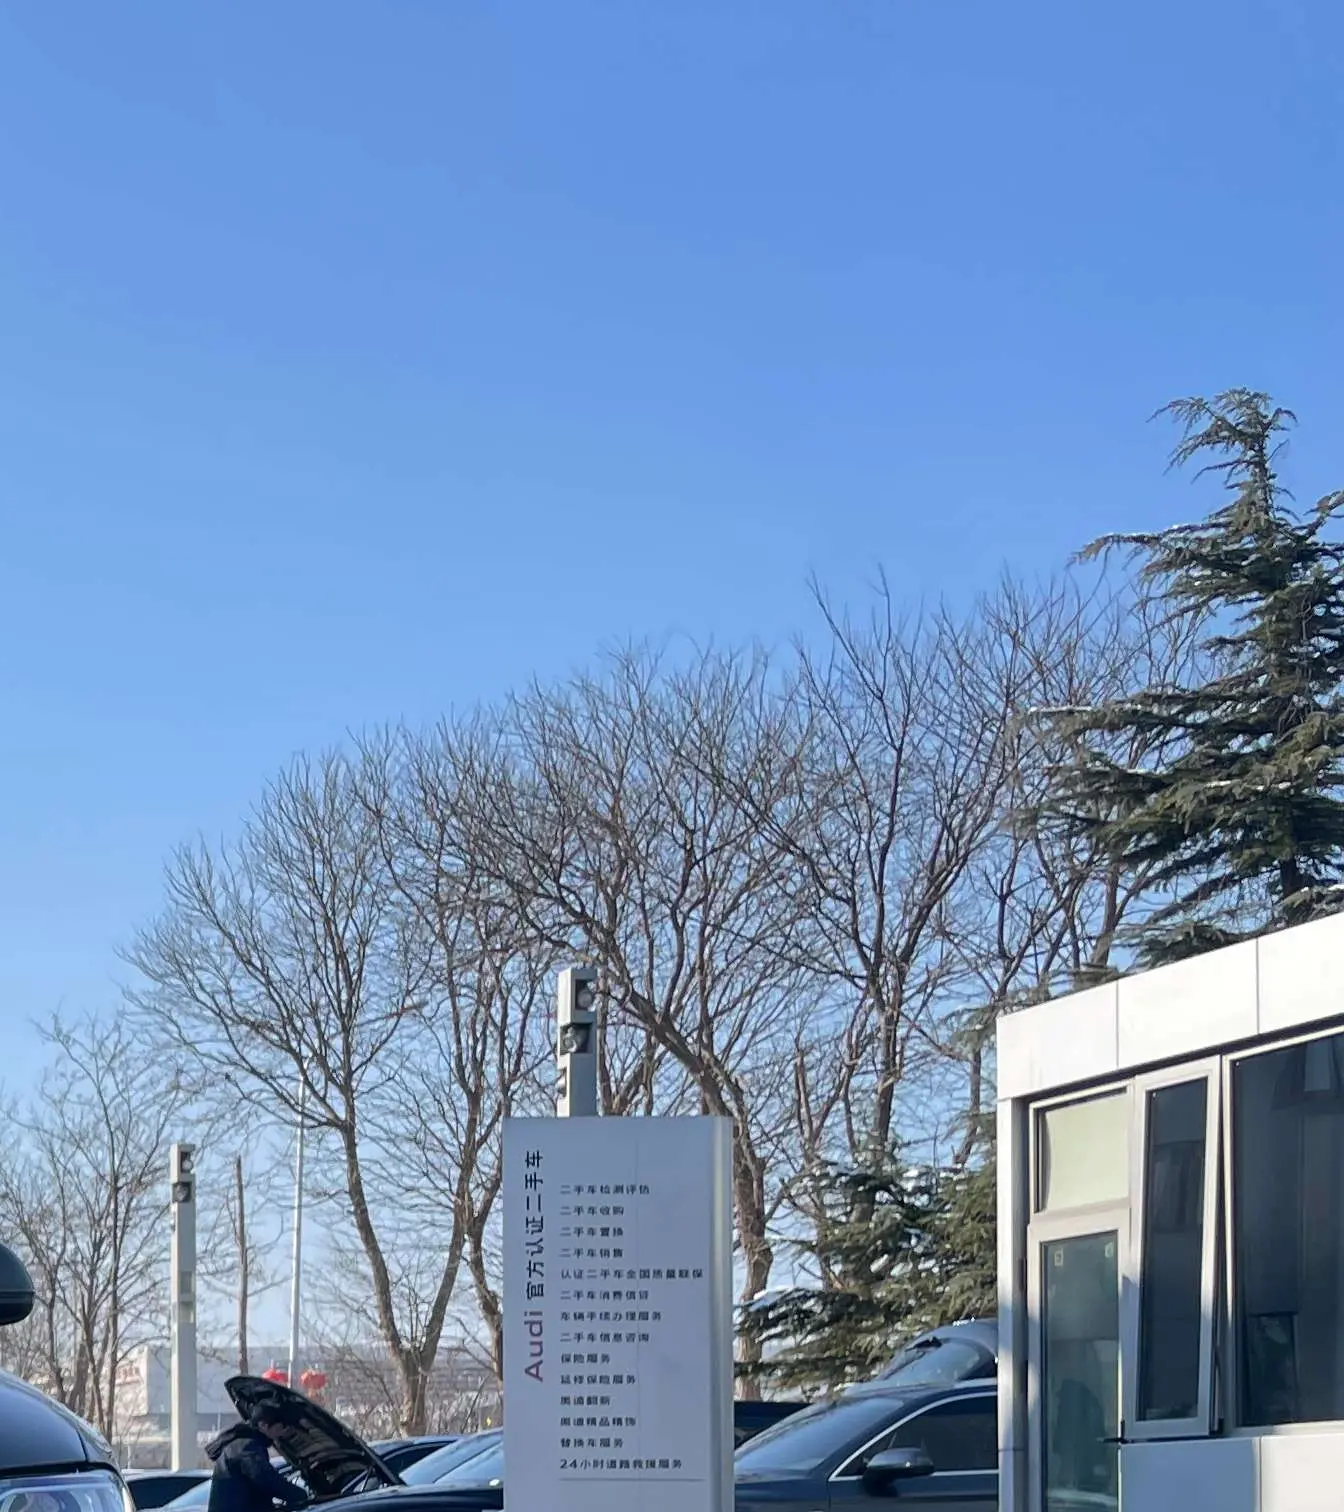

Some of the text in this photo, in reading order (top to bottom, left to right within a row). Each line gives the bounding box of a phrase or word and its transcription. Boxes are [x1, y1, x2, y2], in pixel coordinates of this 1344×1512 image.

[560, 1205, 624, 1216] 二手车收购
[560, 1226, 623, 1237] 二手车置换
[524, 1150, 545, 1383] Audi 官方认证二手车
[560, 1352, 610, 1363] 保险服务
